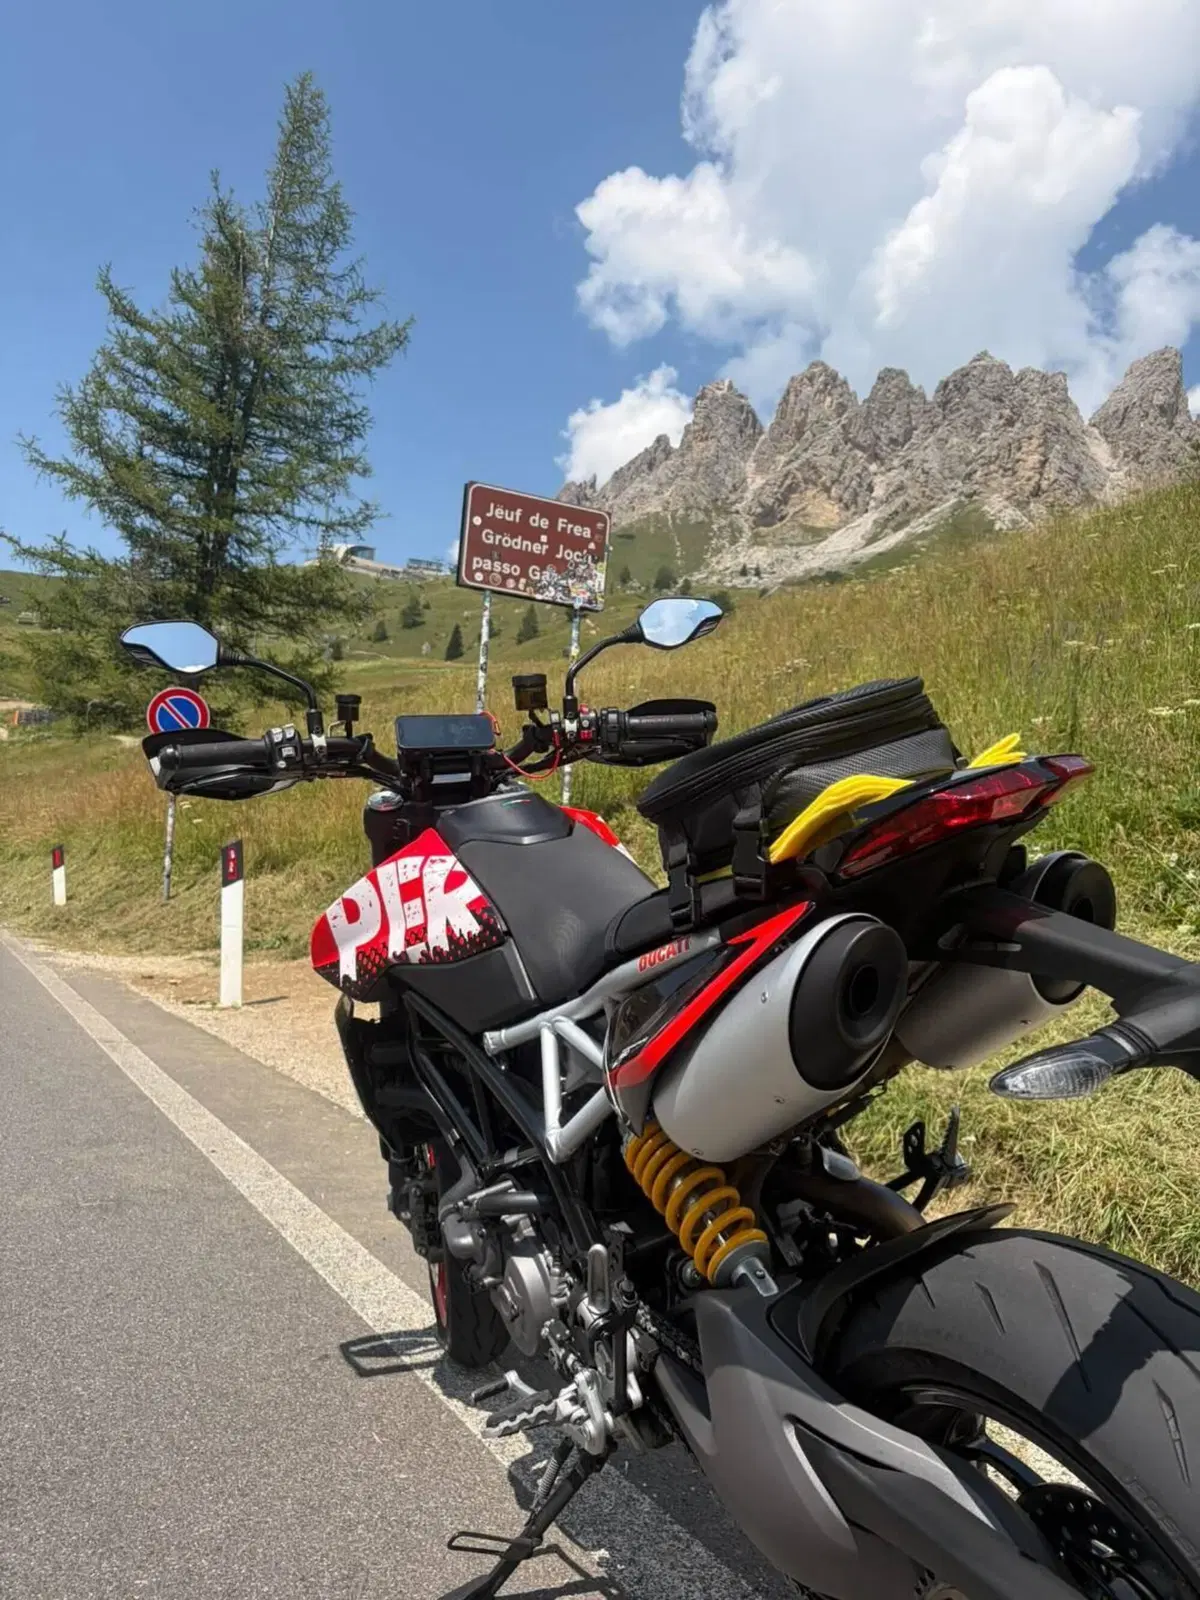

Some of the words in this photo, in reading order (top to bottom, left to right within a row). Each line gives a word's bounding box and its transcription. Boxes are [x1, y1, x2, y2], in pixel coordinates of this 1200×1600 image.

[486, 502, 523, 523] Jëuf
[529, 513, 549, 529] de
[557, 517, 592, 539] Frea
[482, 528, 549, 555] Grödner
[472, 556, 521, 576] passo
[637, 935, 690, 973] DUCATI
